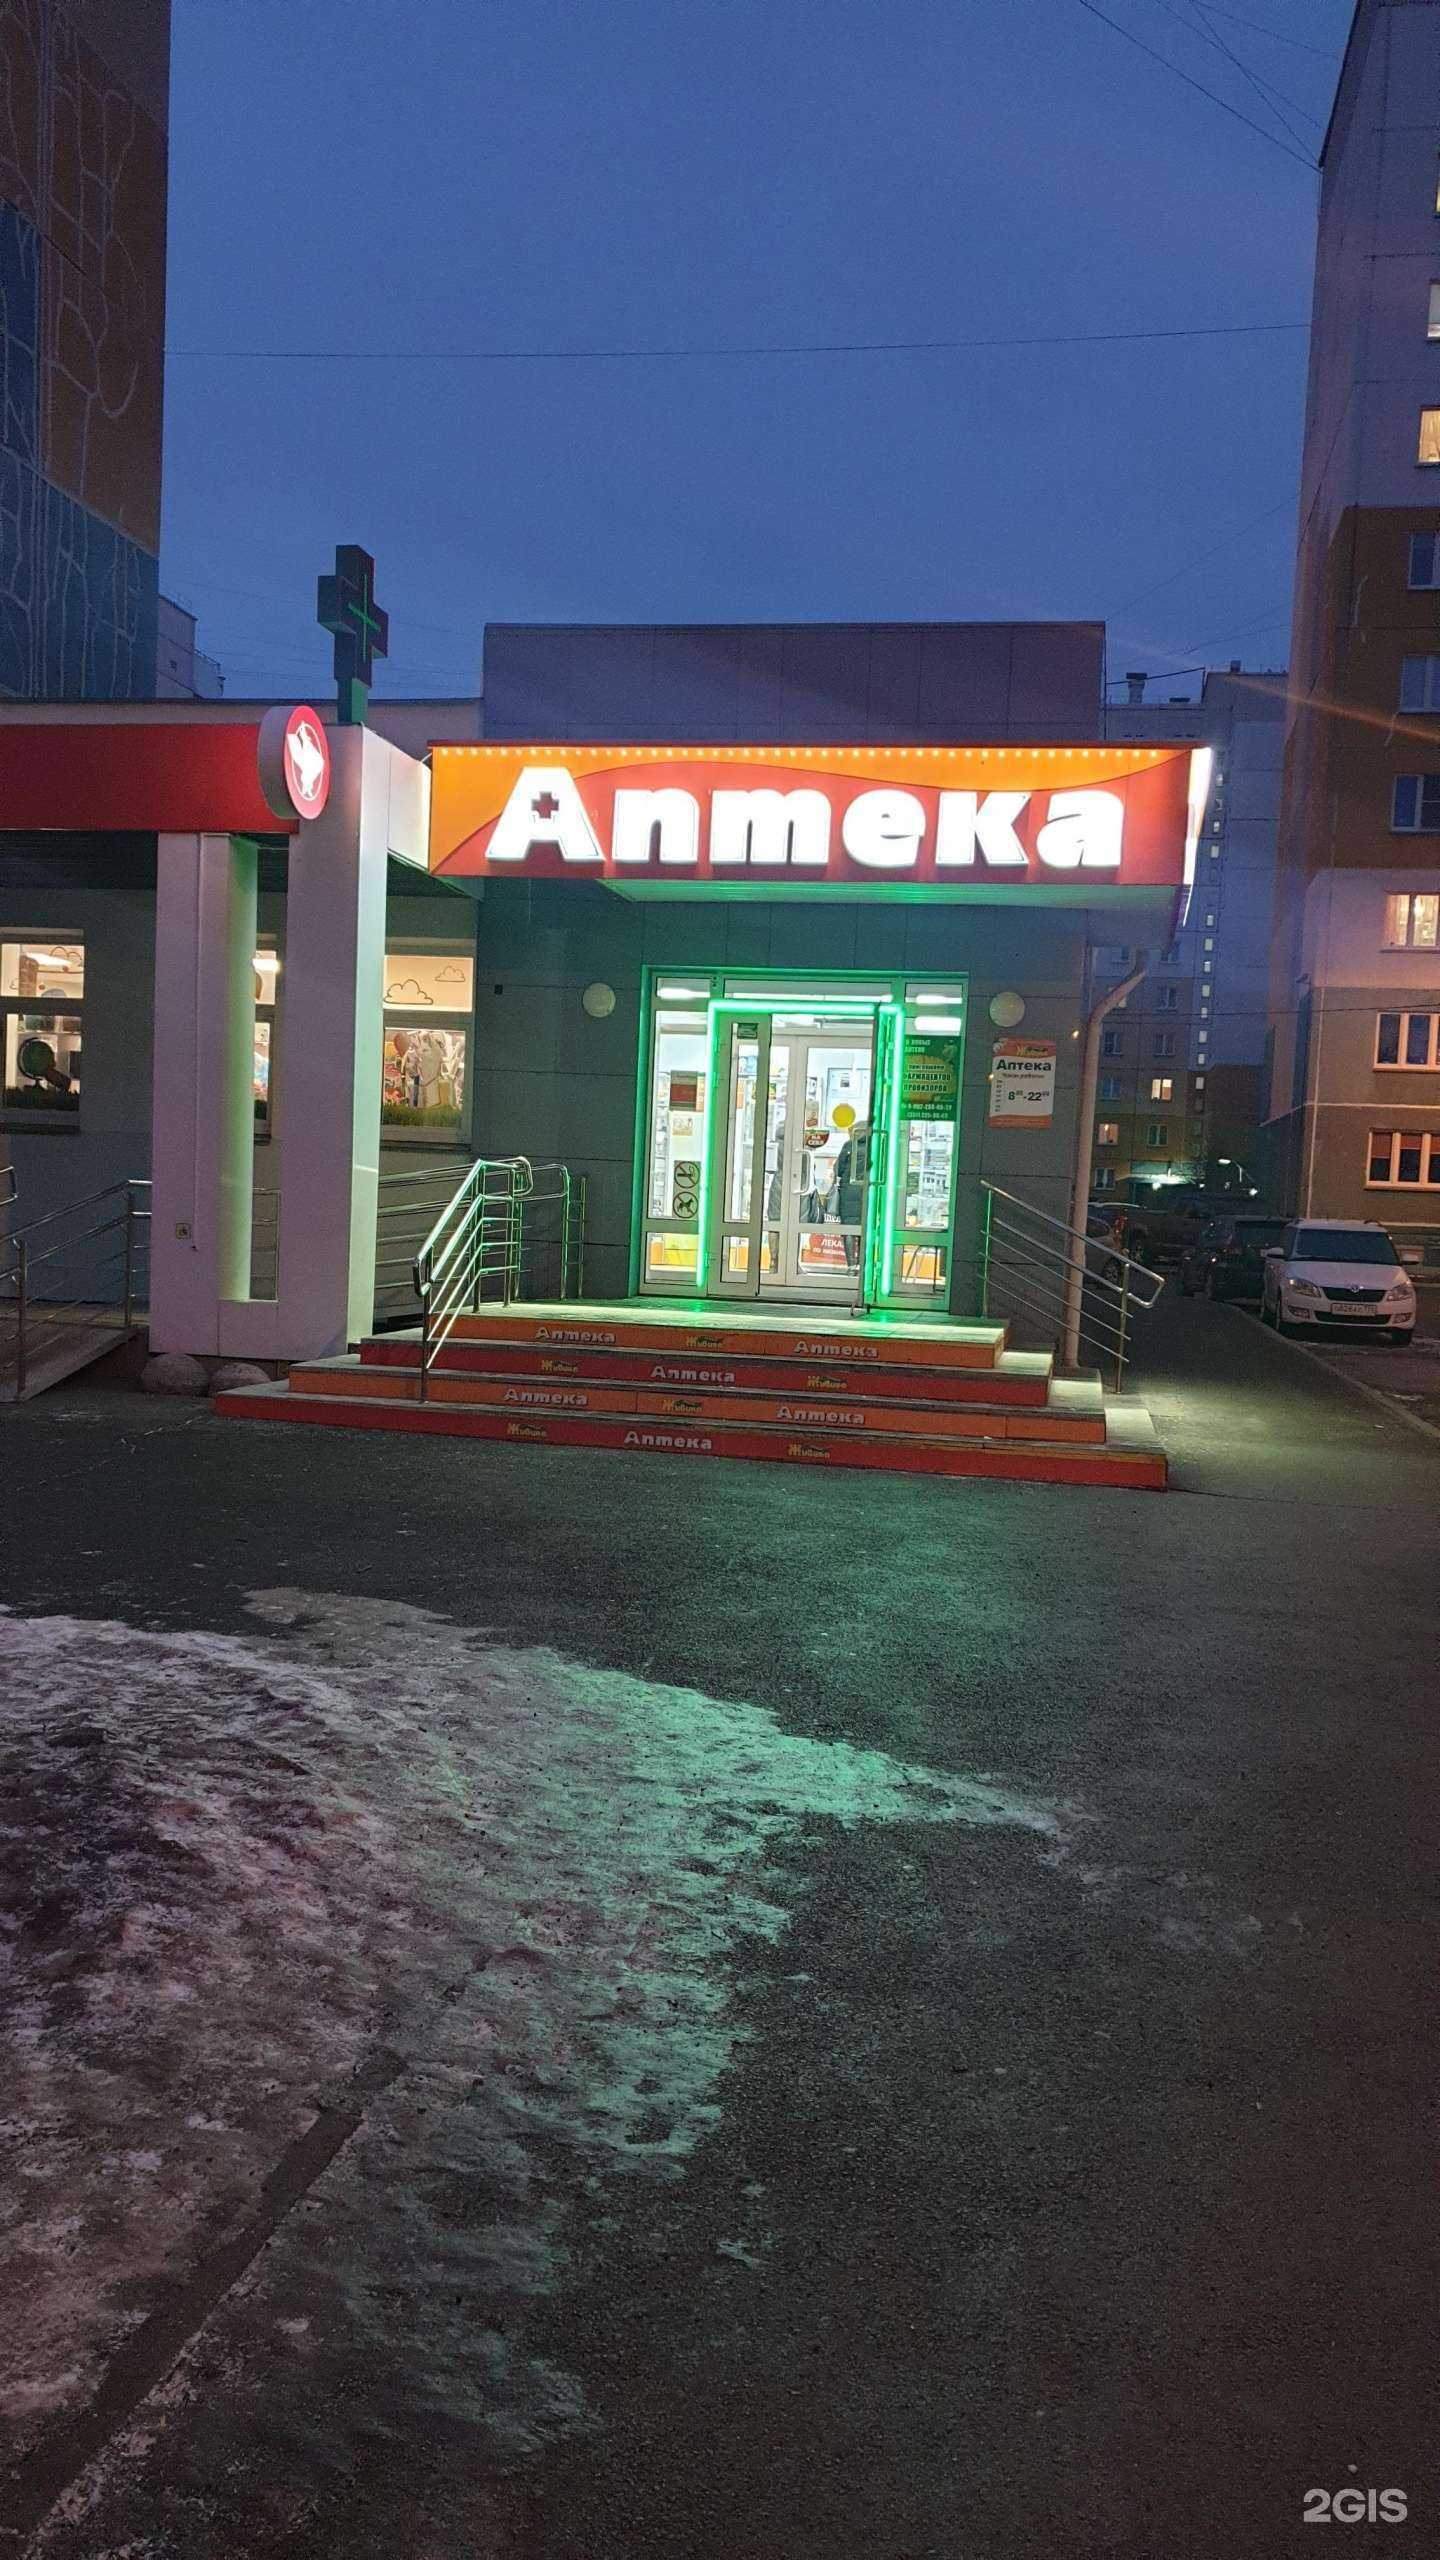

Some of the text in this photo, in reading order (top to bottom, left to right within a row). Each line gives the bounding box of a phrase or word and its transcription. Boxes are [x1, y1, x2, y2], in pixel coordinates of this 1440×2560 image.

[484, 766, 1125, 867] Аптека
[996, 1059, 1052, 1071] Аптека
[535, 1326, 616, 1344] Аптека
[794, 1341, 878, 1358] Аптека
[651, 1365, 735, 1382] Аптека
[503, 1388, 588, 1406] Аптека
[776, 1406, 865, 1425] Аптека
[624, 1431, 713, 1450] Аптека
